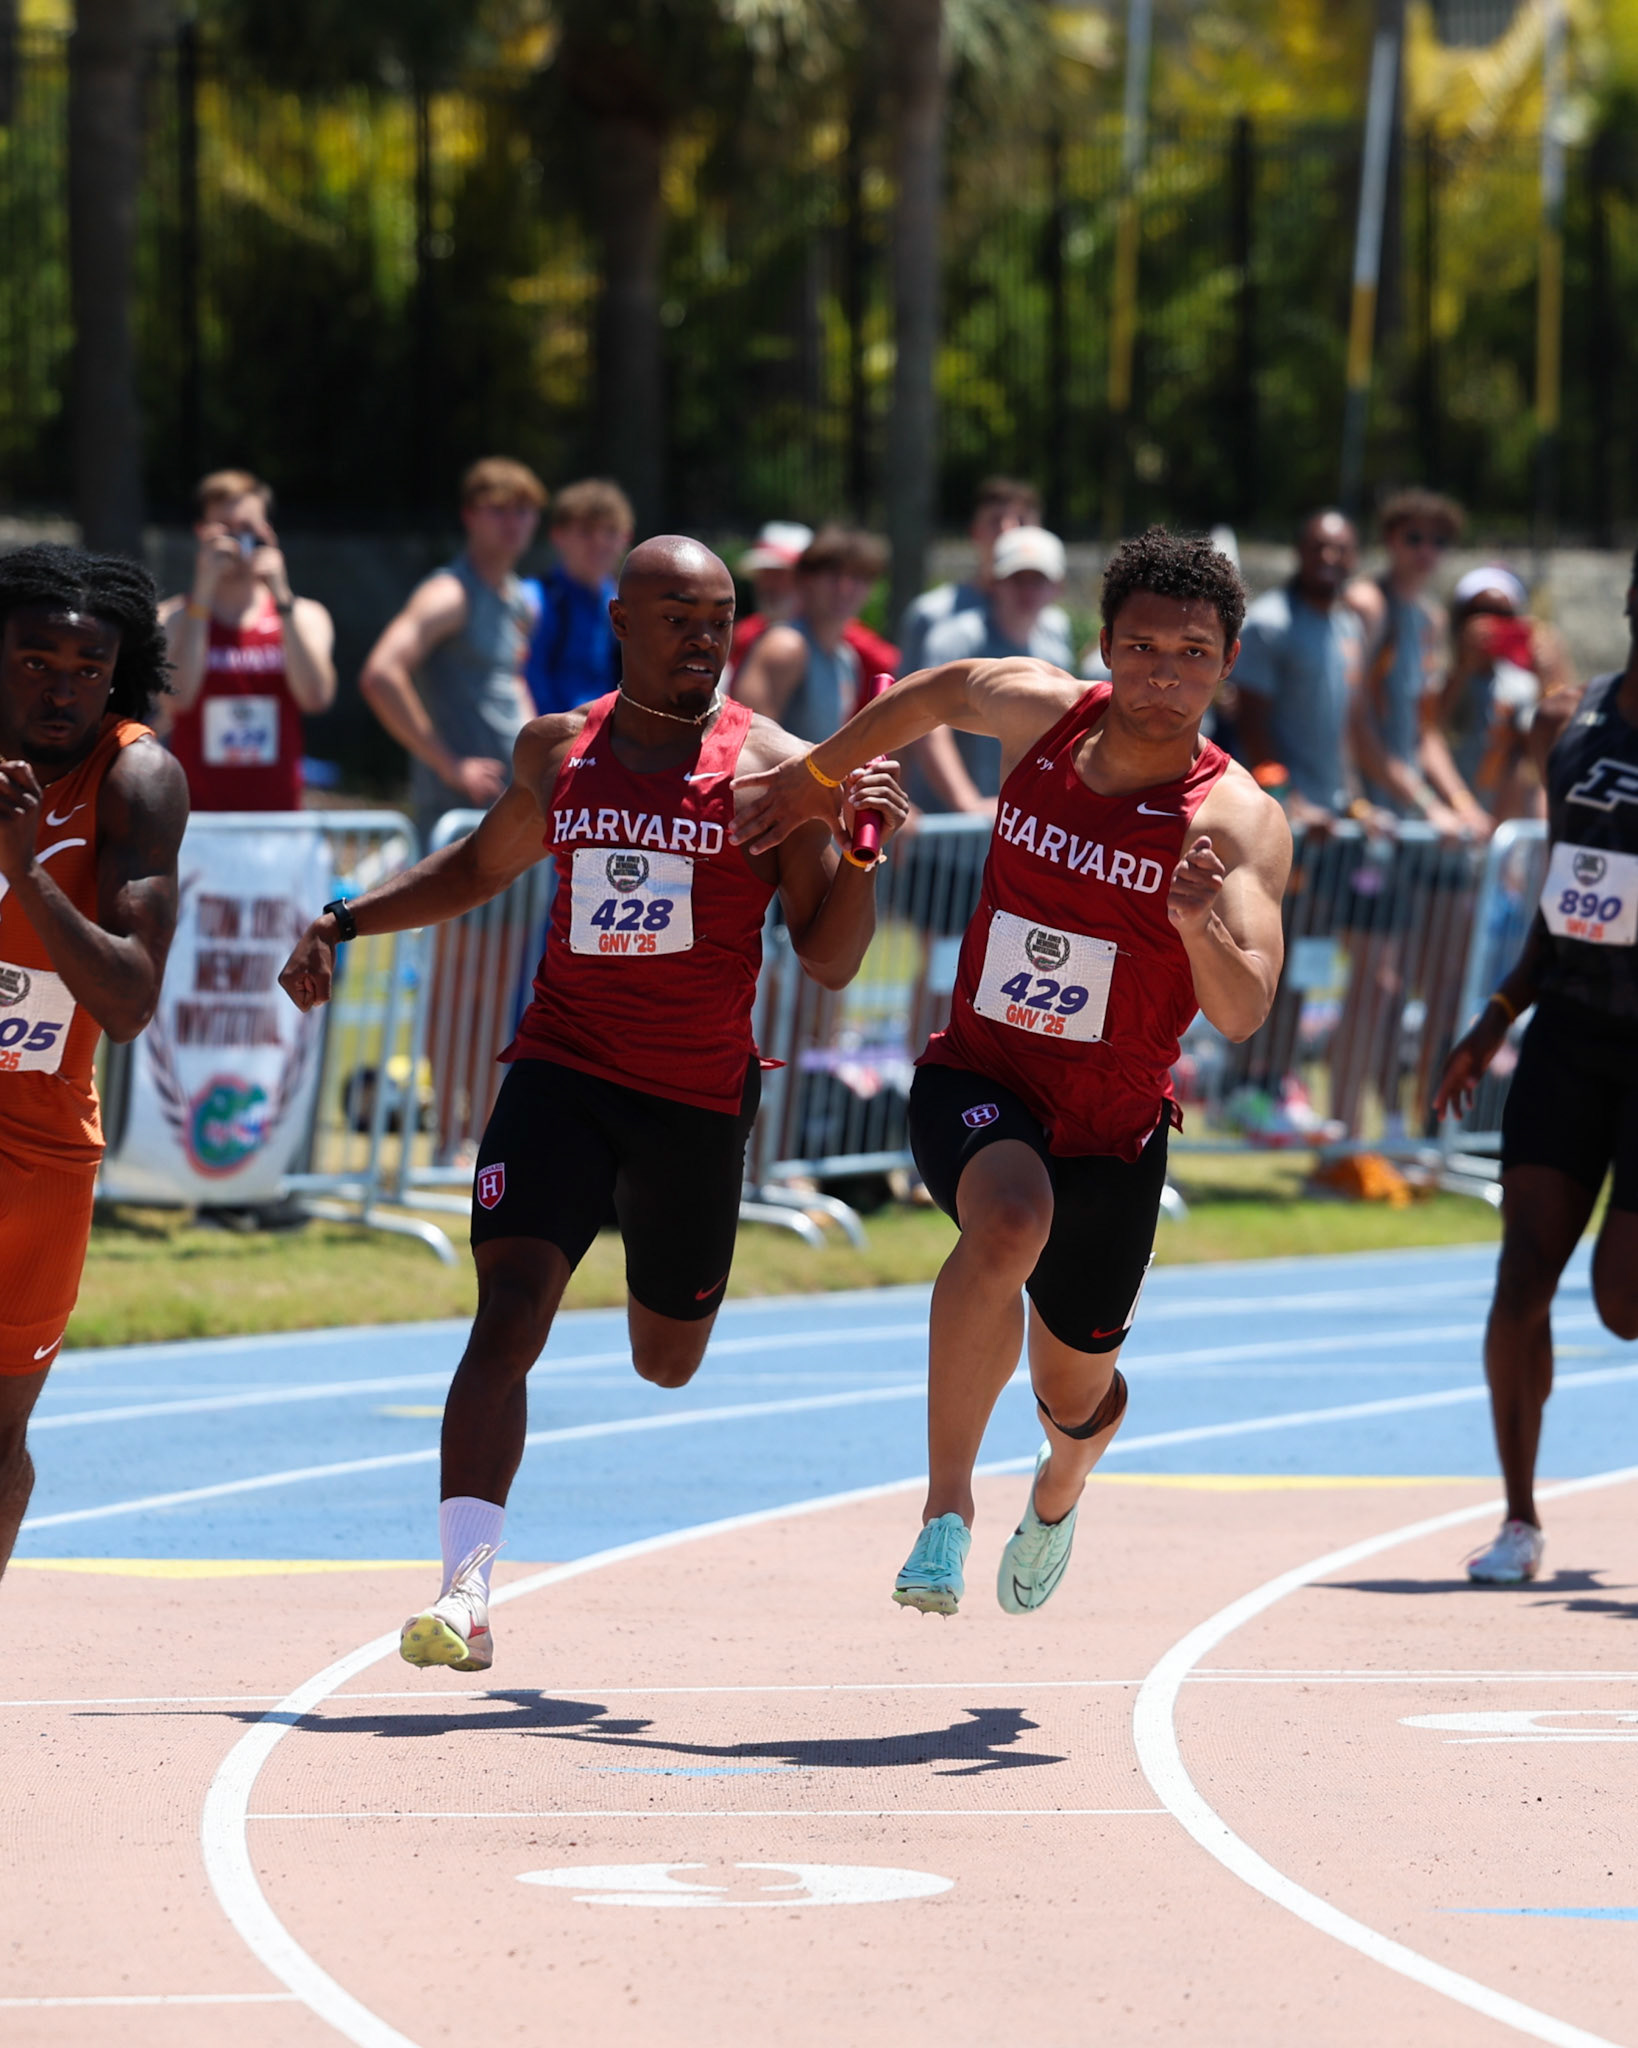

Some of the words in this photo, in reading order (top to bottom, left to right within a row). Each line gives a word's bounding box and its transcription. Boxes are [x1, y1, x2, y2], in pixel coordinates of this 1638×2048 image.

[553, 808, 725, 855] HARVARD
[997, 801, 1164, 894] HARVARD
[590, 898, 674, 931] 428
[1559, 889, 1623, 923] 890
[598, 933, 632, 953] GNV
[1000, 971, 1090, 1015] 429
[1006, 1003, 1041, 1030] GNV
[970, 1107, 993, 1124] H
[482, 1174, 498, 1200] H
